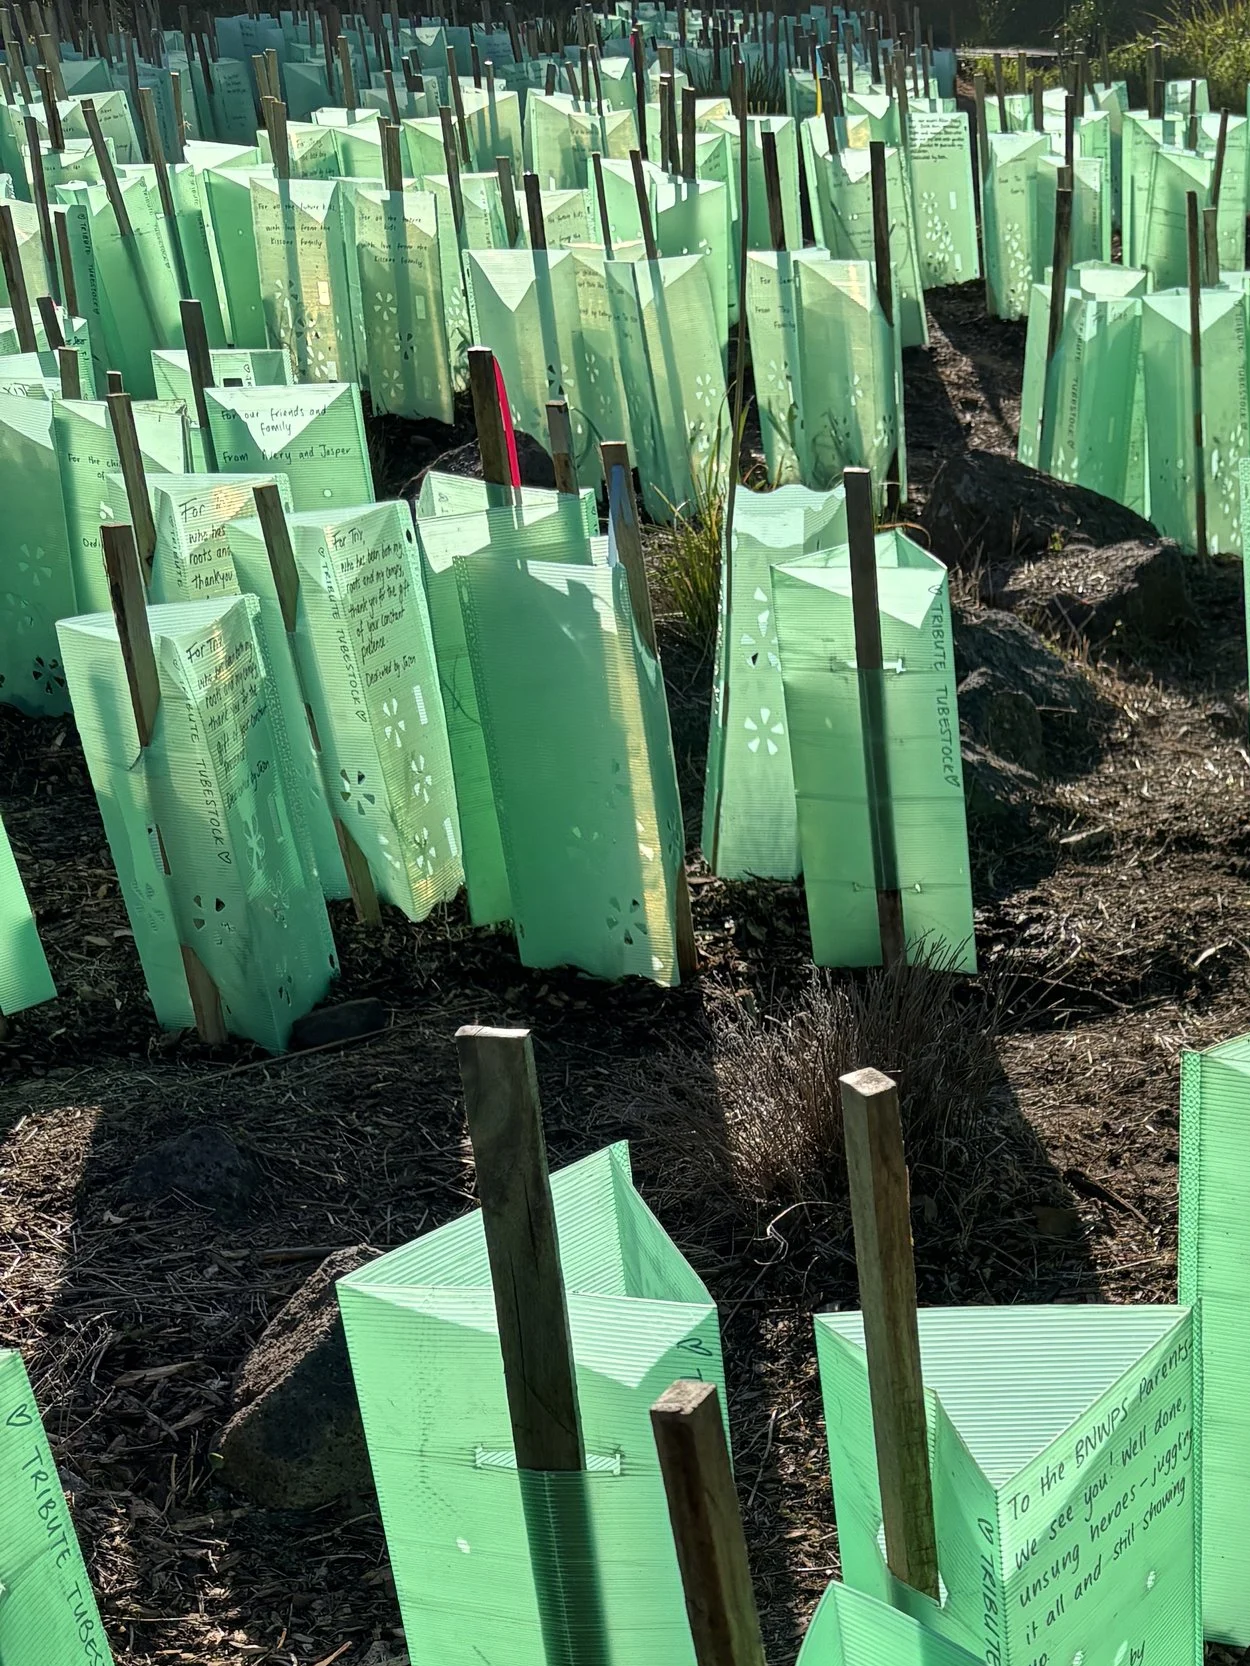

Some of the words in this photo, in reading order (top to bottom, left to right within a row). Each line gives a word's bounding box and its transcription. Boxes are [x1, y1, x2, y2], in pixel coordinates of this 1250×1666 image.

[80, 222, 91, 256] TRIBUTE
[88, 264, 98, 309] TUBESTOCK
[222, 410, 237, 420] For
[310, 406, 328, 416] and
[223, 454, 249, 464] From
[299, 446, 315, 458] and
[319, 444, 352, 458] Jasper
[178, 498, 206, 522] For
[190, 548, 212, 565] roots
[332, 530, 346, 550] For
[368, 548, 380, 564] been
[347, 577, 360, 594] roots
[363, 569, 374, 586] and
[348, 597, 368, 618] thank
[387, 585, 396, 596] the
[322, 564, 340, 620] TRIBUTE
[336, 629, 360, 710] TUBESTOCK
[357, 620, 364, 642] of
[931, 603, 946, 672] TRIBUTE
[186, 642, 206, 663] For
[394, 660, 401, 678] by
[936, 686, 954, 773] TUBESTOCK
[196, 758, 224, 846] TUBESTOCK
[1007, 1493, 1031, 1521] To
[1039, 1458, 1066, 1499] the
[1074, 1397, 1129, 1470] BNWPS
[1015, 1538, 1038, 1571] We
[1048, 1505, 1075, 1542] see
[1153, 1397, 1188, 1436] done,
[20, 1445, 73, 1570] TRIBUTE
[1019, 1543, 1081, 1608] unsung
[1025, 1621, 1039, 1646] it
[1046, 1592, 1066, 1627] all
[1073, 1554, 1103, 1601] and
[1112, 1522, 1136, 1562] still
[1142, 1475, 1187, 1533] showing
